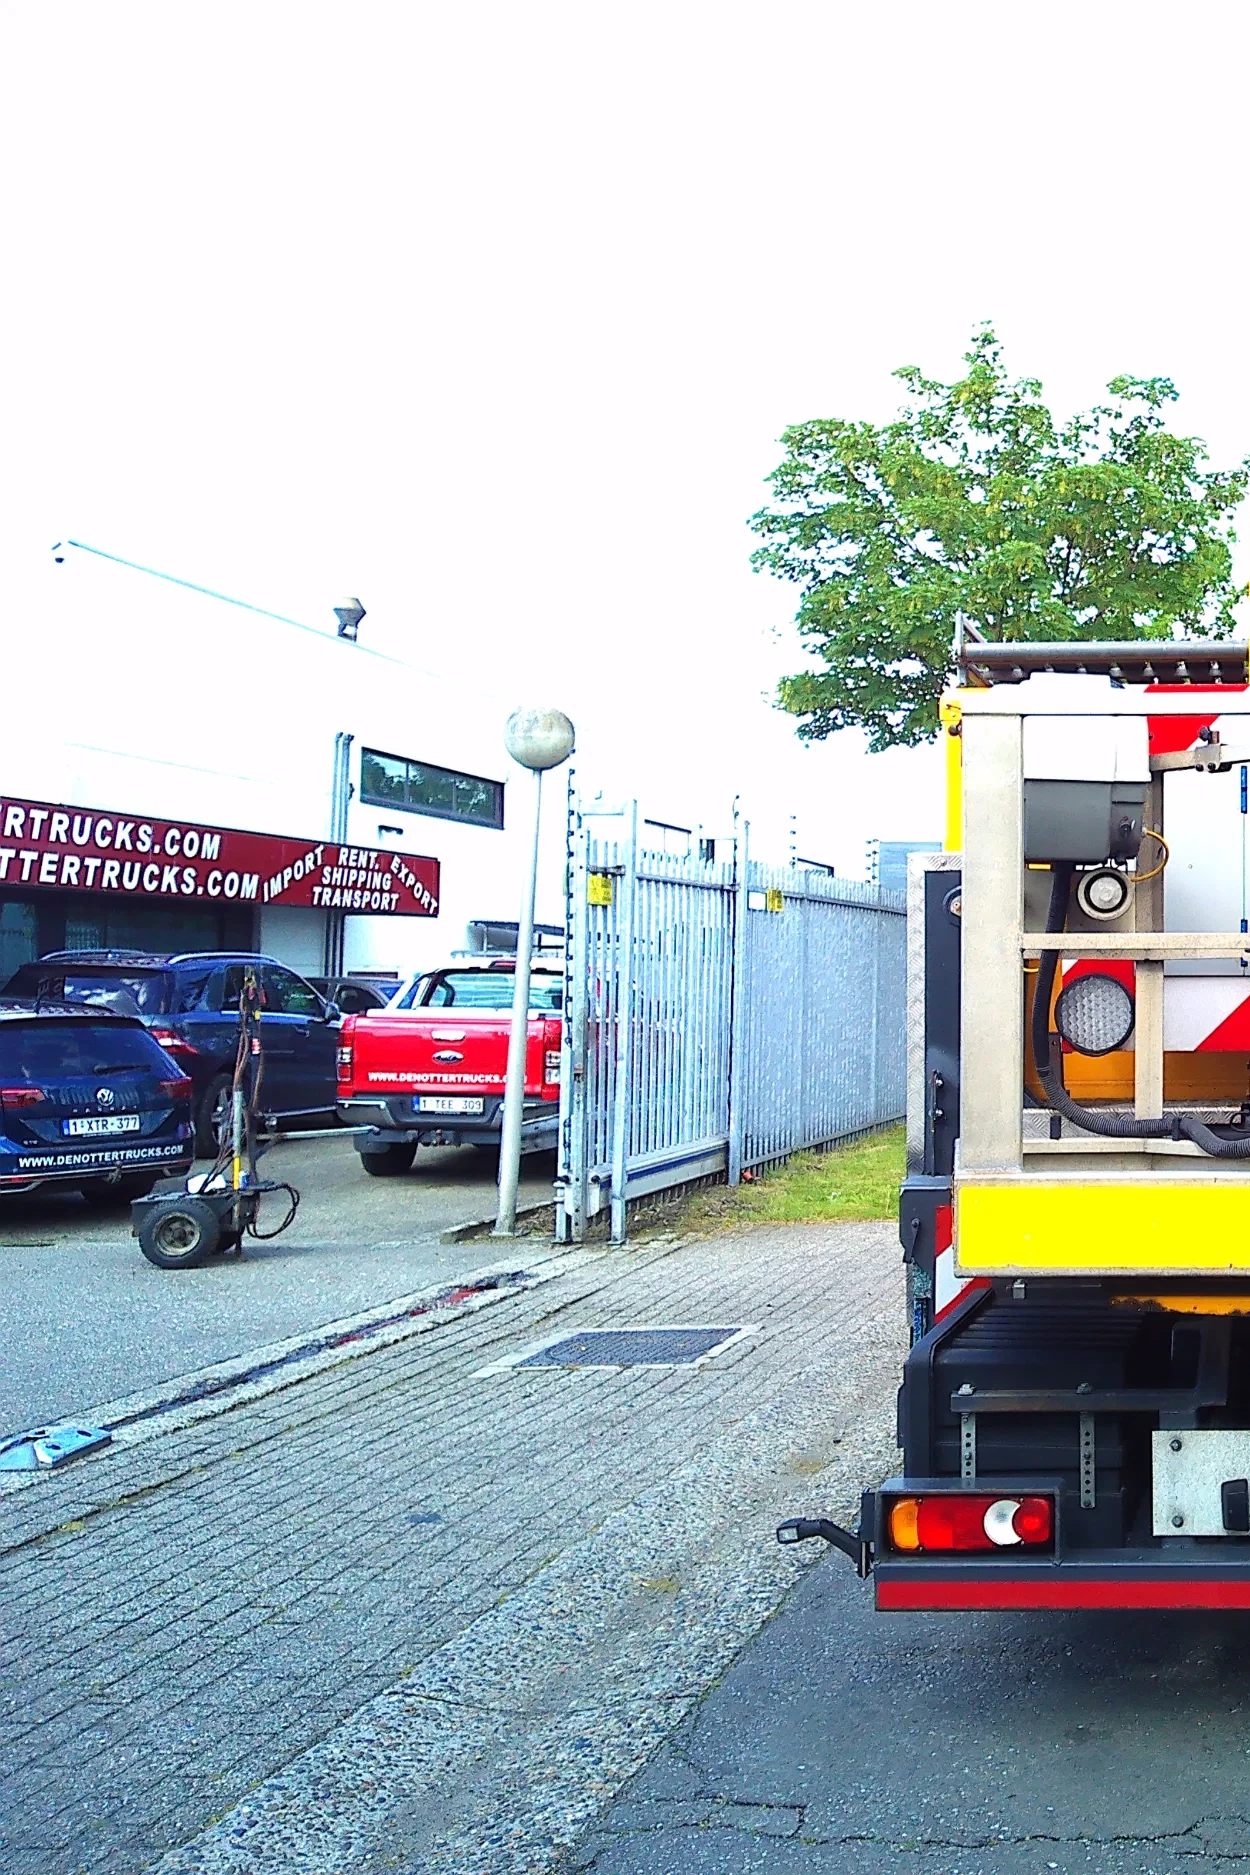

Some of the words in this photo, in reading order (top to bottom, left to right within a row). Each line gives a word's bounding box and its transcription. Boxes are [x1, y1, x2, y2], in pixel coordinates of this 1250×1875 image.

[0, 804, 221, 861] RTRUCKS.COM
[263, 845, 324, 903] IMPORT
[390, 855, 438, 915] EXPORT
[321, 866, 392, 891] SHIPPING
[312, 886, 399, 912] TRANSPORT
[368, 1071, 527, 1084] WWW.DENOTTERTRUCKS.C
[19, 1144, 184, 1168] WWW.DENOTTERTRUCKS.COM
